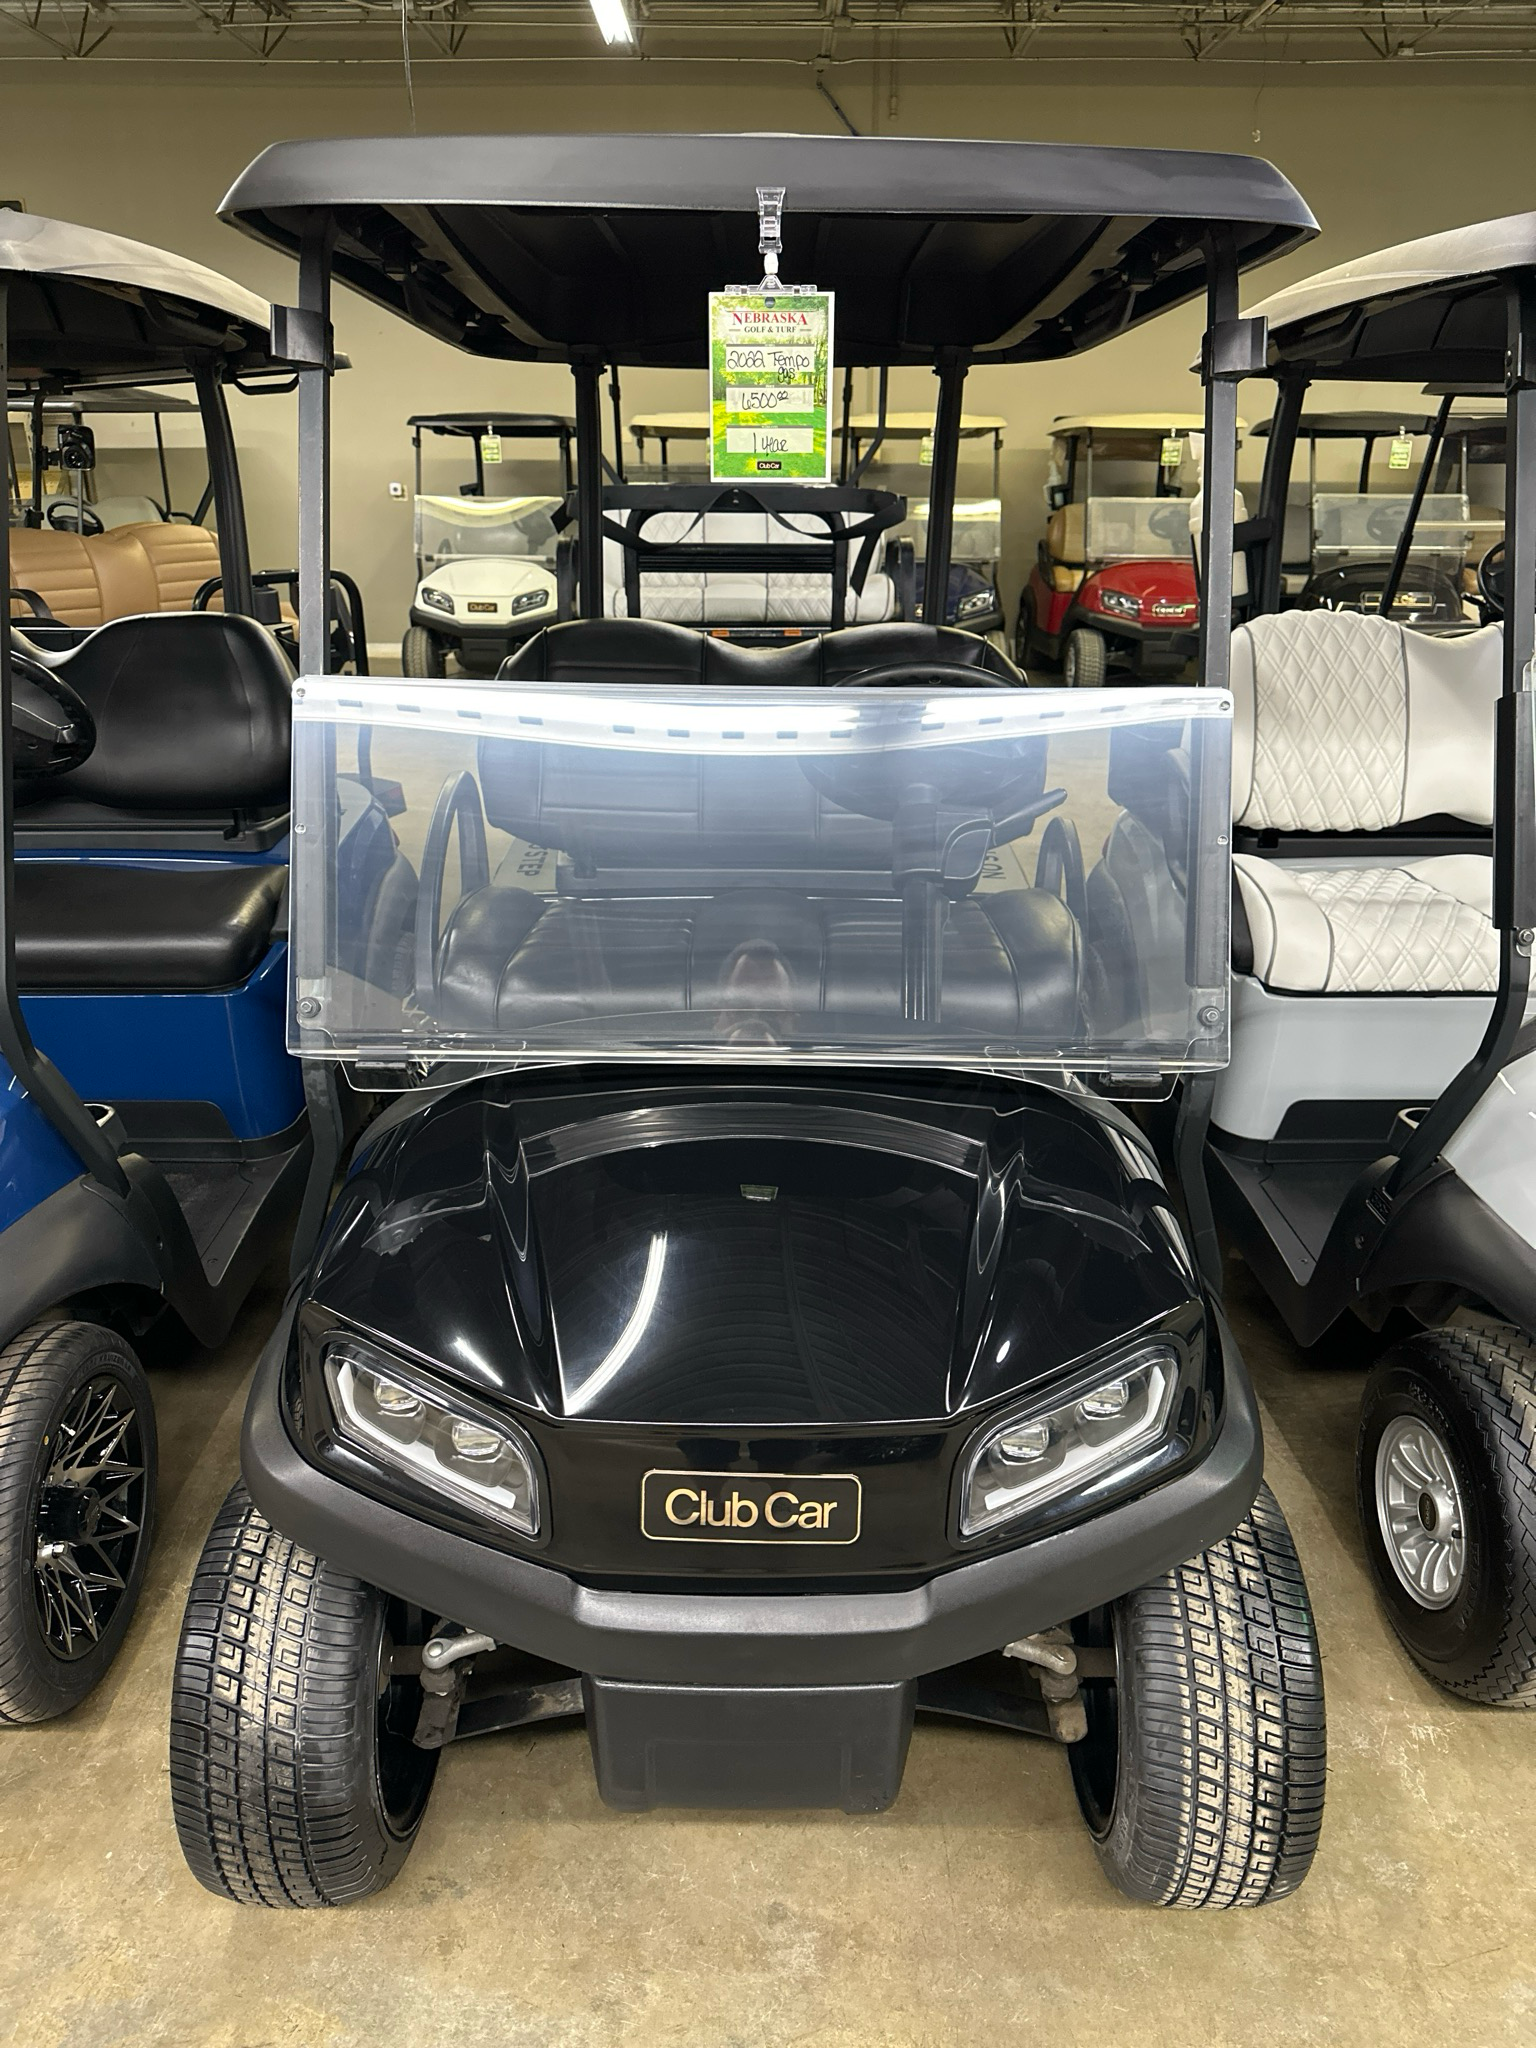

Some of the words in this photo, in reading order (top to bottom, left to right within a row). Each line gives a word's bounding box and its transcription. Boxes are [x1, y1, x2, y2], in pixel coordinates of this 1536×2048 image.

[732, 312, 808, 325] NEBRASKA
[727, 350, 766, 370] 2022
[767, 351, 810, 371] Tempo
[665, 1488, 759, 1528] Club
[764, 1491, 837, 1529] Car
